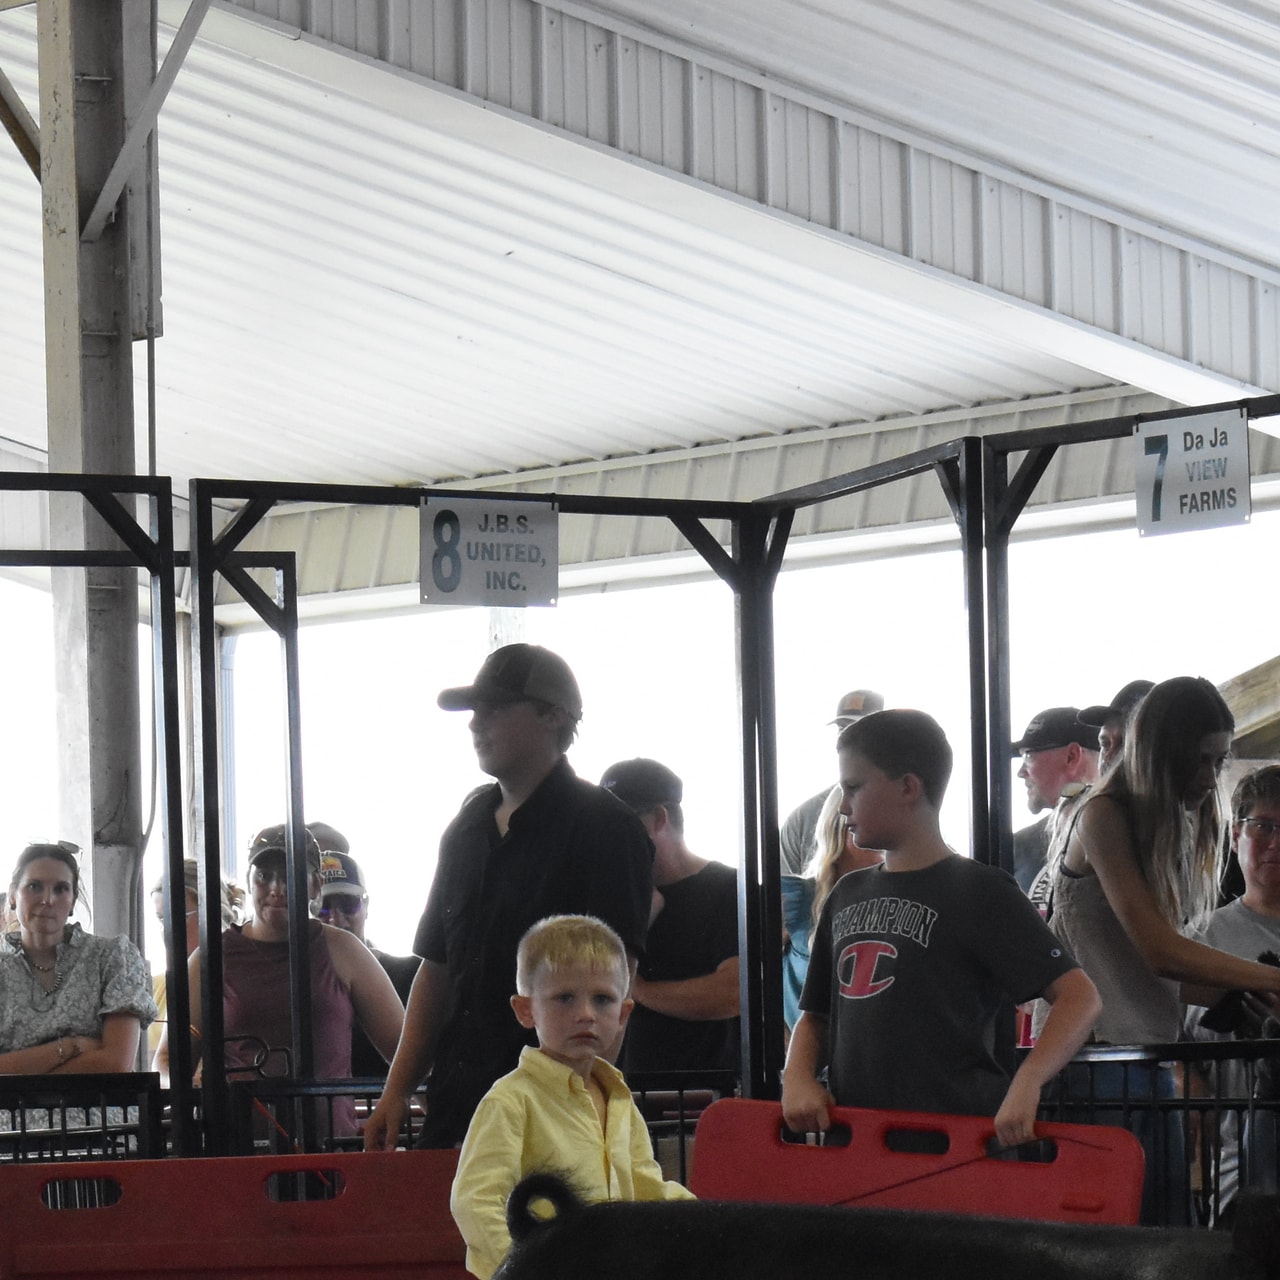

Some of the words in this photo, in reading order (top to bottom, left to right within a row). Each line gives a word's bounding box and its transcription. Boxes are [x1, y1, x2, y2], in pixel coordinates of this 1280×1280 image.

[1183, 431, 1204, 452] Da
[1209, 427, 1228, 448] Ja
[1144, 434, 1168, 522] 7
[1184, 457, 1228, 482] VIEW
[1179, 487, 1237, 515] FARMS
[478, 513, 534, 534] J.B.S.
[432, 509, 462, 593] 8
[466, 541, 546, 567] UNITED,
[486, 571, 527, 591] INC.
[832, 897, 938, 948] CHAMPION
